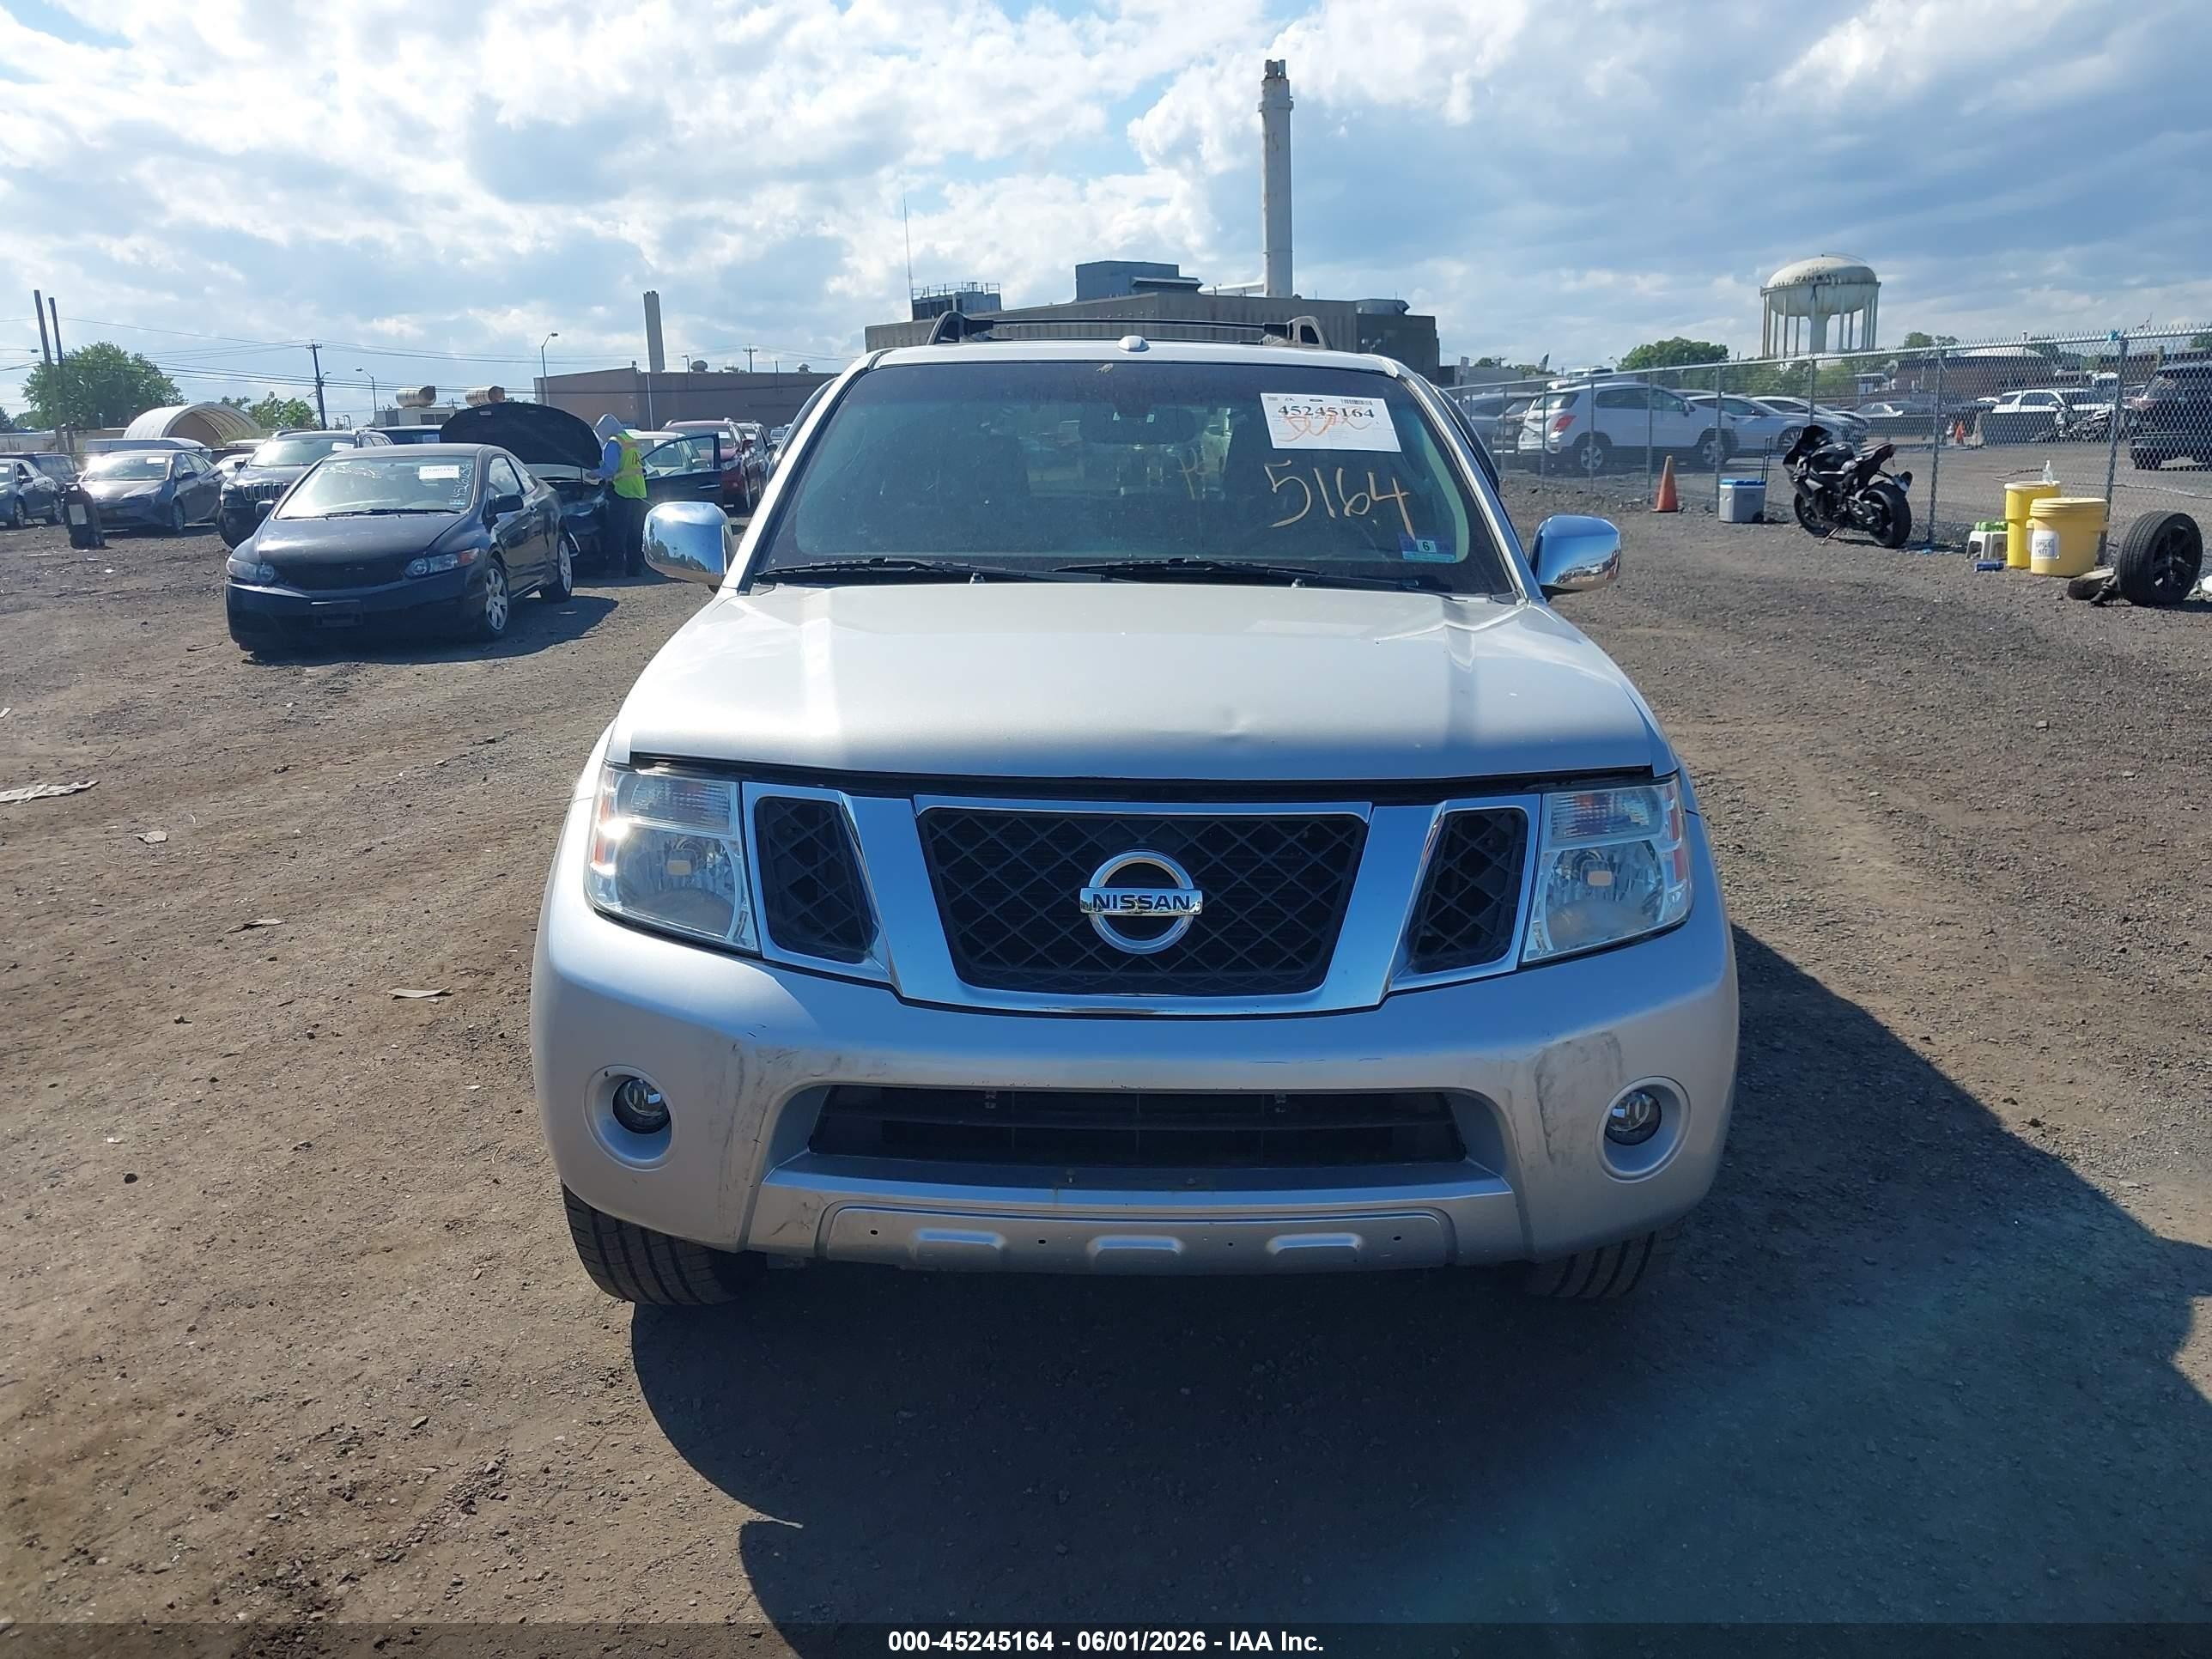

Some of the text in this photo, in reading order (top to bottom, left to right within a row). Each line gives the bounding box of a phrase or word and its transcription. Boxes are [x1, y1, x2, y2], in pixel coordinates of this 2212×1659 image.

[1278, 404, 1375, 419] 45245164
[1263, 459, 1416, 542] 5164
[1092, 893, 1190, 911] NISSAN
